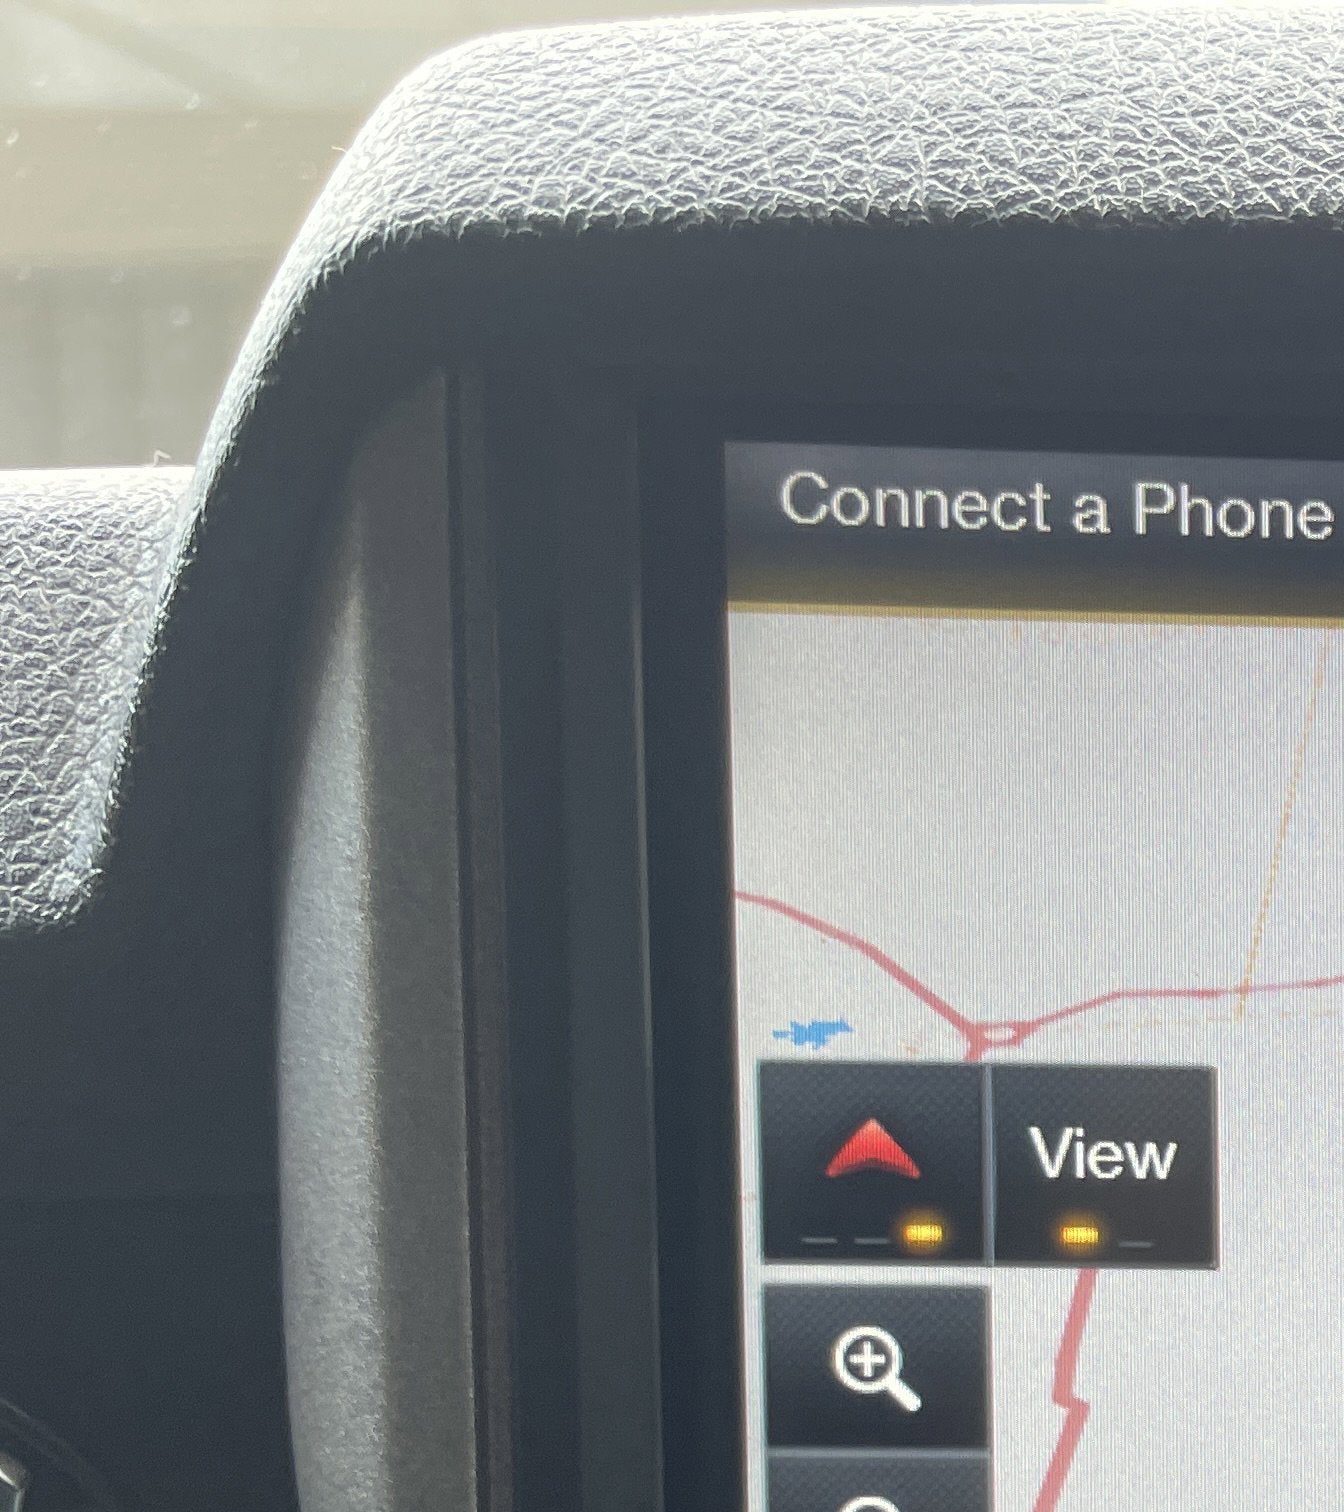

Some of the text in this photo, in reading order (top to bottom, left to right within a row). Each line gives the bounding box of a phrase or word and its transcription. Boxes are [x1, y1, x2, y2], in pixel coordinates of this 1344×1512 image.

[779, 470, 1336, 540] Connect a Phone
[1028, 1125, 1177, 1180] View
